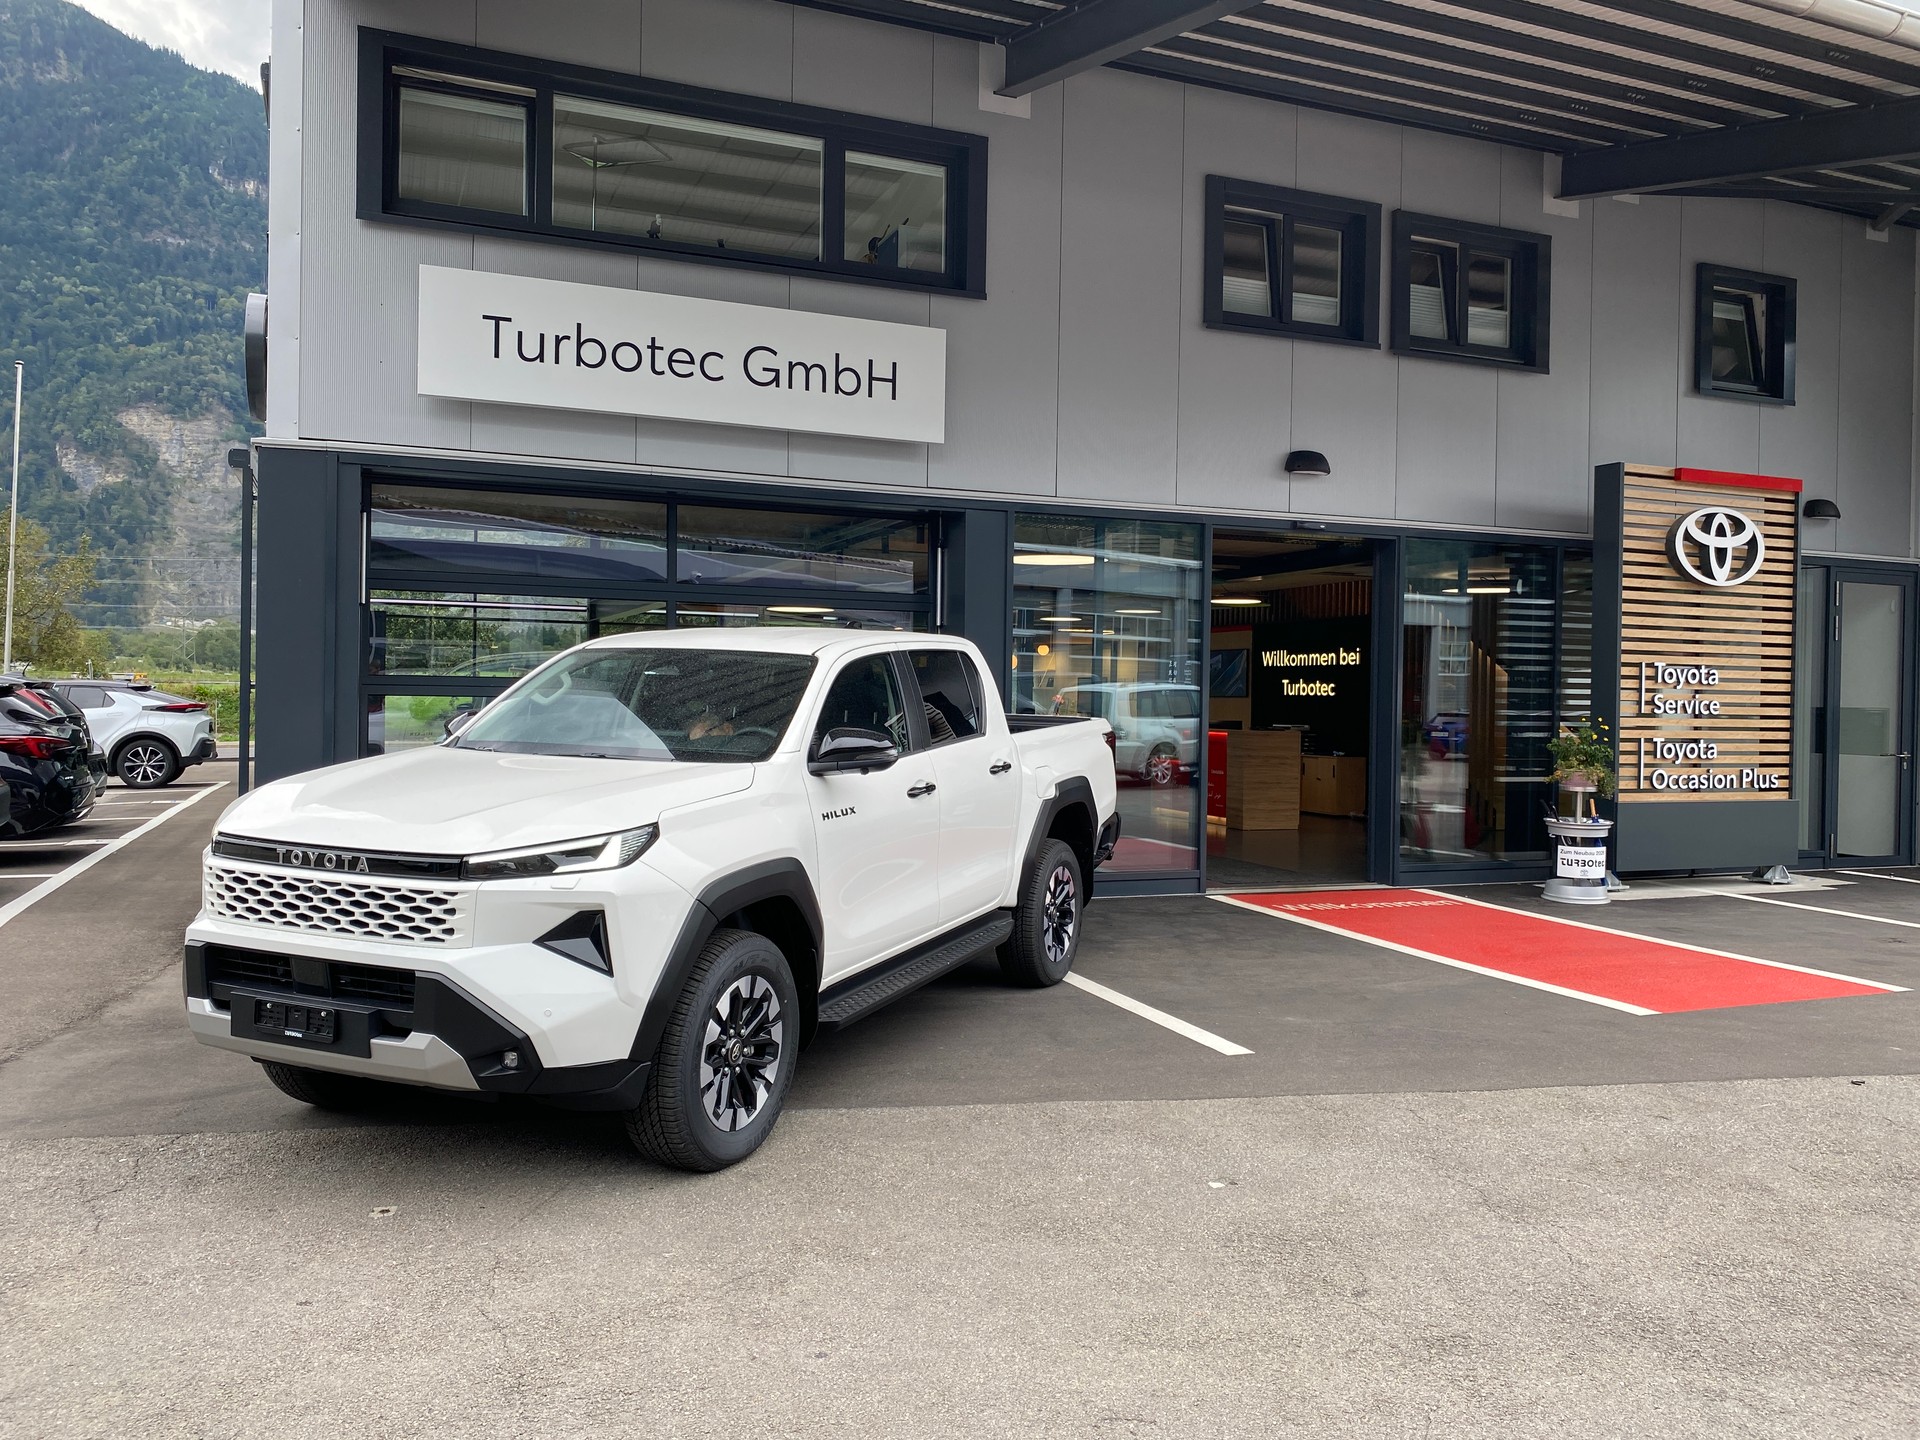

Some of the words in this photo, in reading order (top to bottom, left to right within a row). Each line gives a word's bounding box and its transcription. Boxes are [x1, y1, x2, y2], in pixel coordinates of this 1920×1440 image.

[482, 314, 725, 382] Turbotec
[743, 345, 898, 401] GmbH
[1262, 649, 1336, 667] Willkommen
[1339, 647, 1361, 666] bei
[1654, 662, 1719, 689] Toyota
[1282, 679, 1336, 697] Turbotec
[1653, 693, 1720, 715] Service
[1653, 737, 1718, 765] Toyota
[1652, 768, 1737, 790] Occasion
[1742, 768, 1779, 789] Plus
[822, 806, 856, 821] HILUX
[276, 848, 369, 873] TOYOTA
